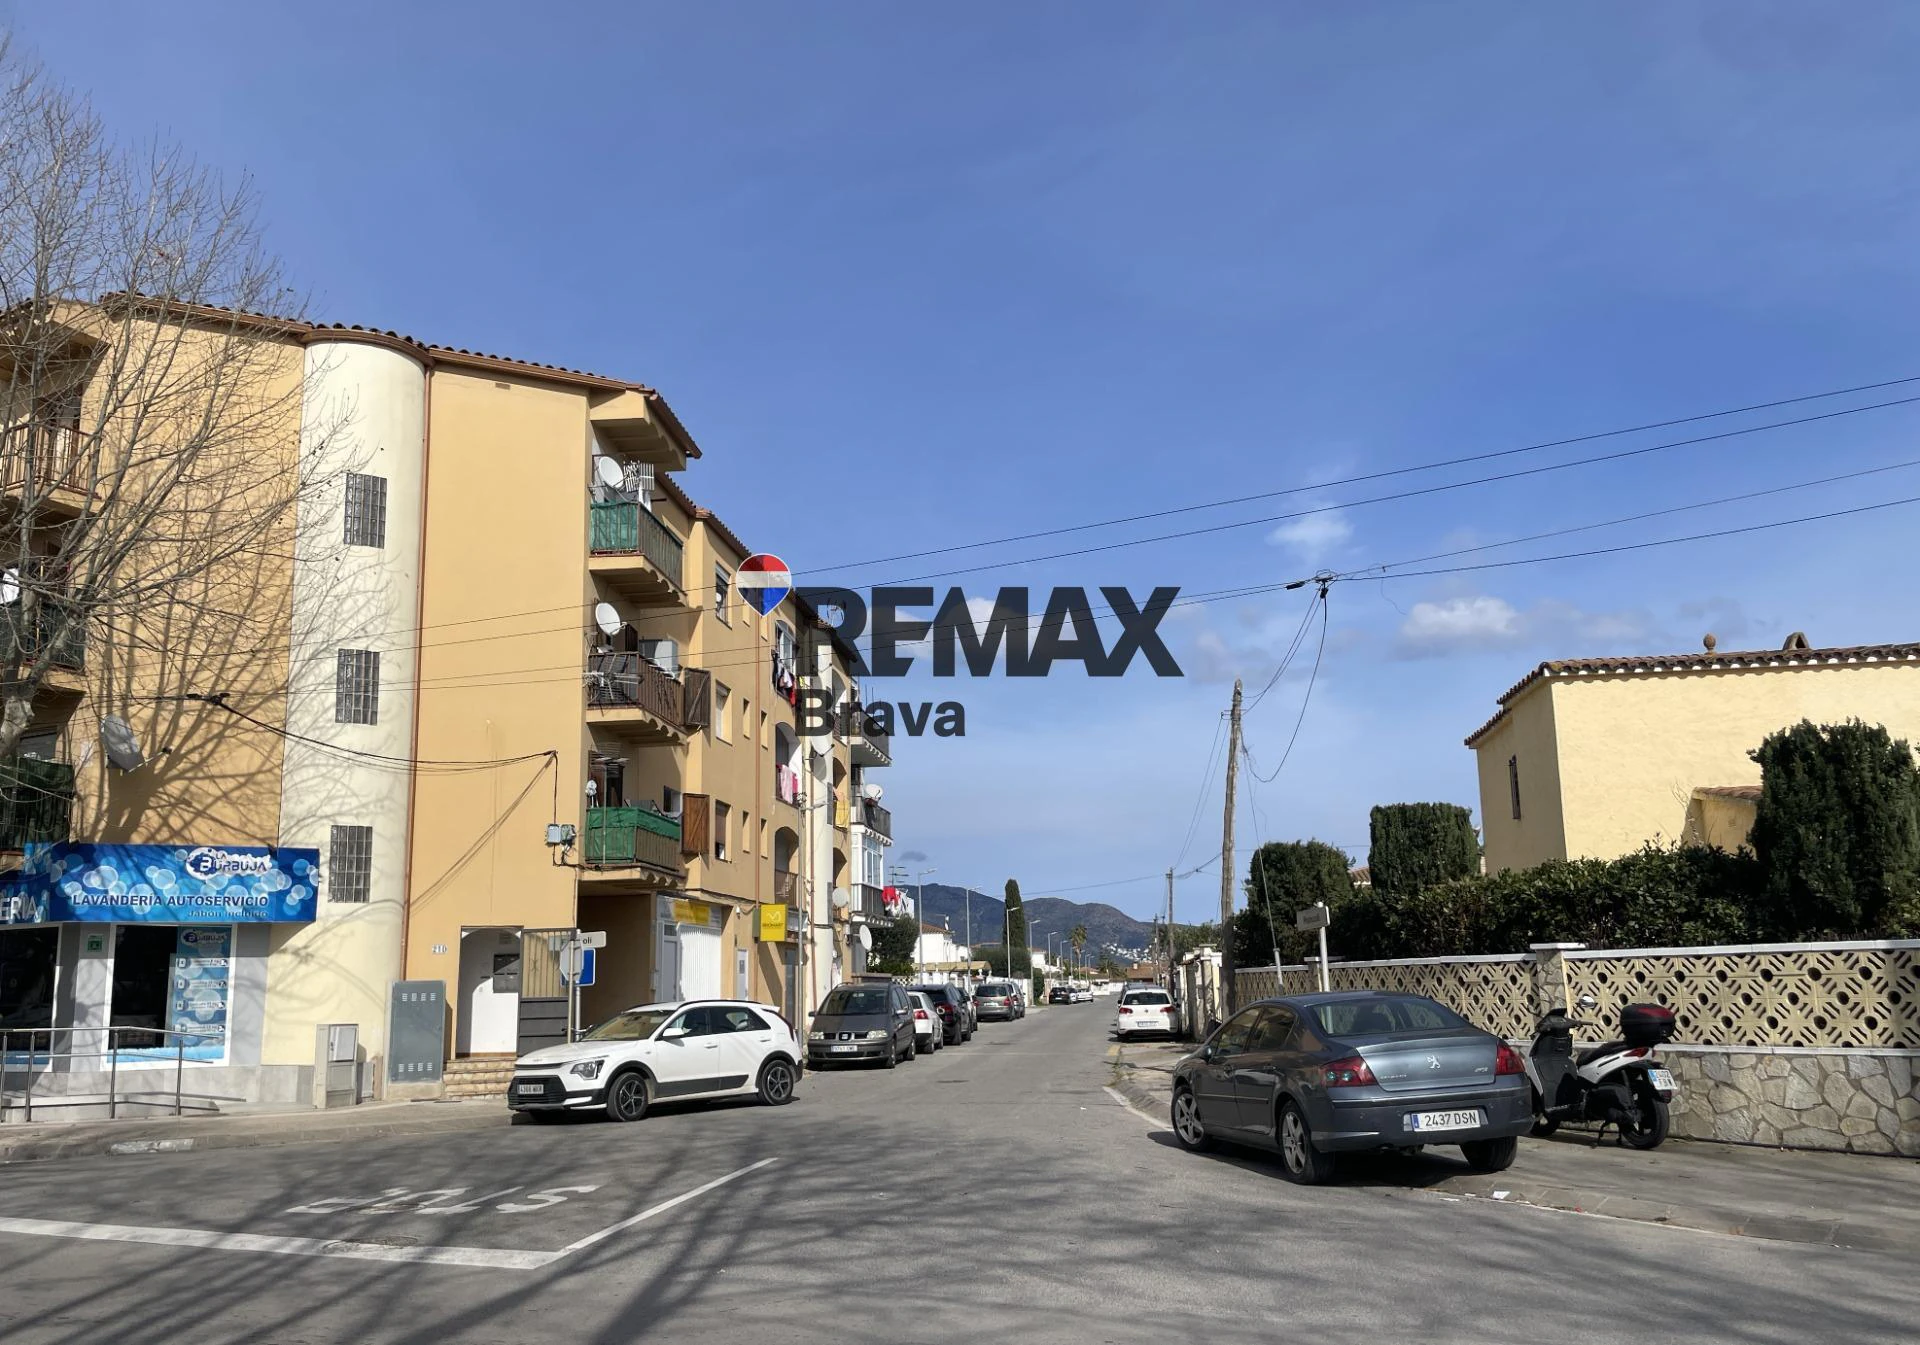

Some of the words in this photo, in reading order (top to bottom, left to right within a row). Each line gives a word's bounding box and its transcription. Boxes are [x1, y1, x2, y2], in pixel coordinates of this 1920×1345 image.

[167, 895, 268, 907] AUTOSERVICIO
[1424, 1113, 1451, 1127] 2437
[1453, 1111, 1477, 1126] DSN
